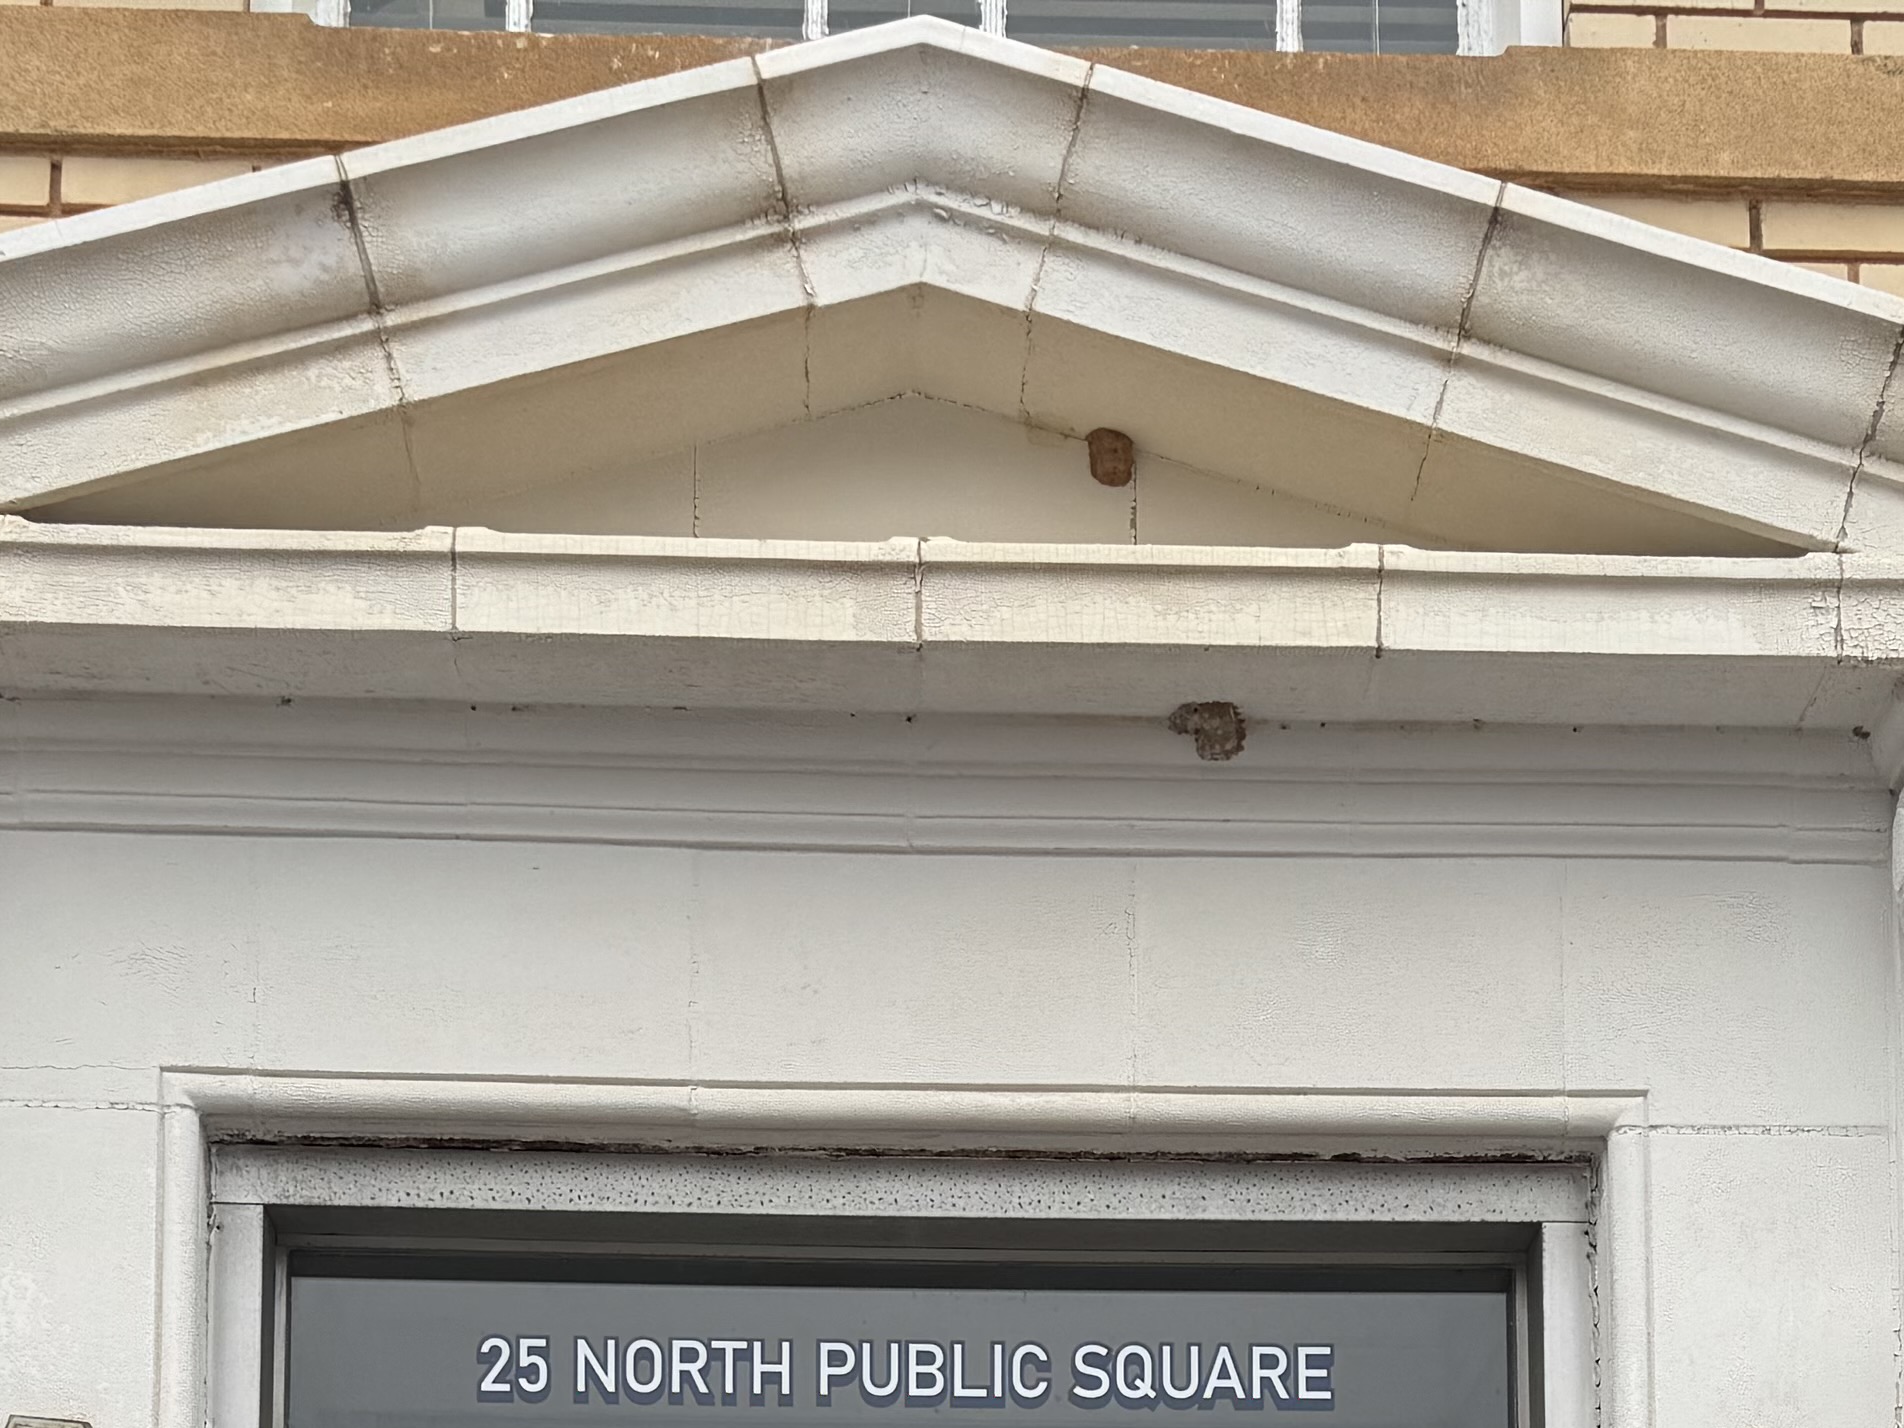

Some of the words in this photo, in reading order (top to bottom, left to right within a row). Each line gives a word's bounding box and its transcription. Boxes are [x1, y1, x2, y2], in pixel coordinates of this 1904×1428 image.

[477, 1337, 551, 1403] 25
[573, 1337, 794, 1407] NORTH
[816, 1339, 1051, 1409] PUBLIC
[1072, 1342, 1336, 1411] SQUARE
